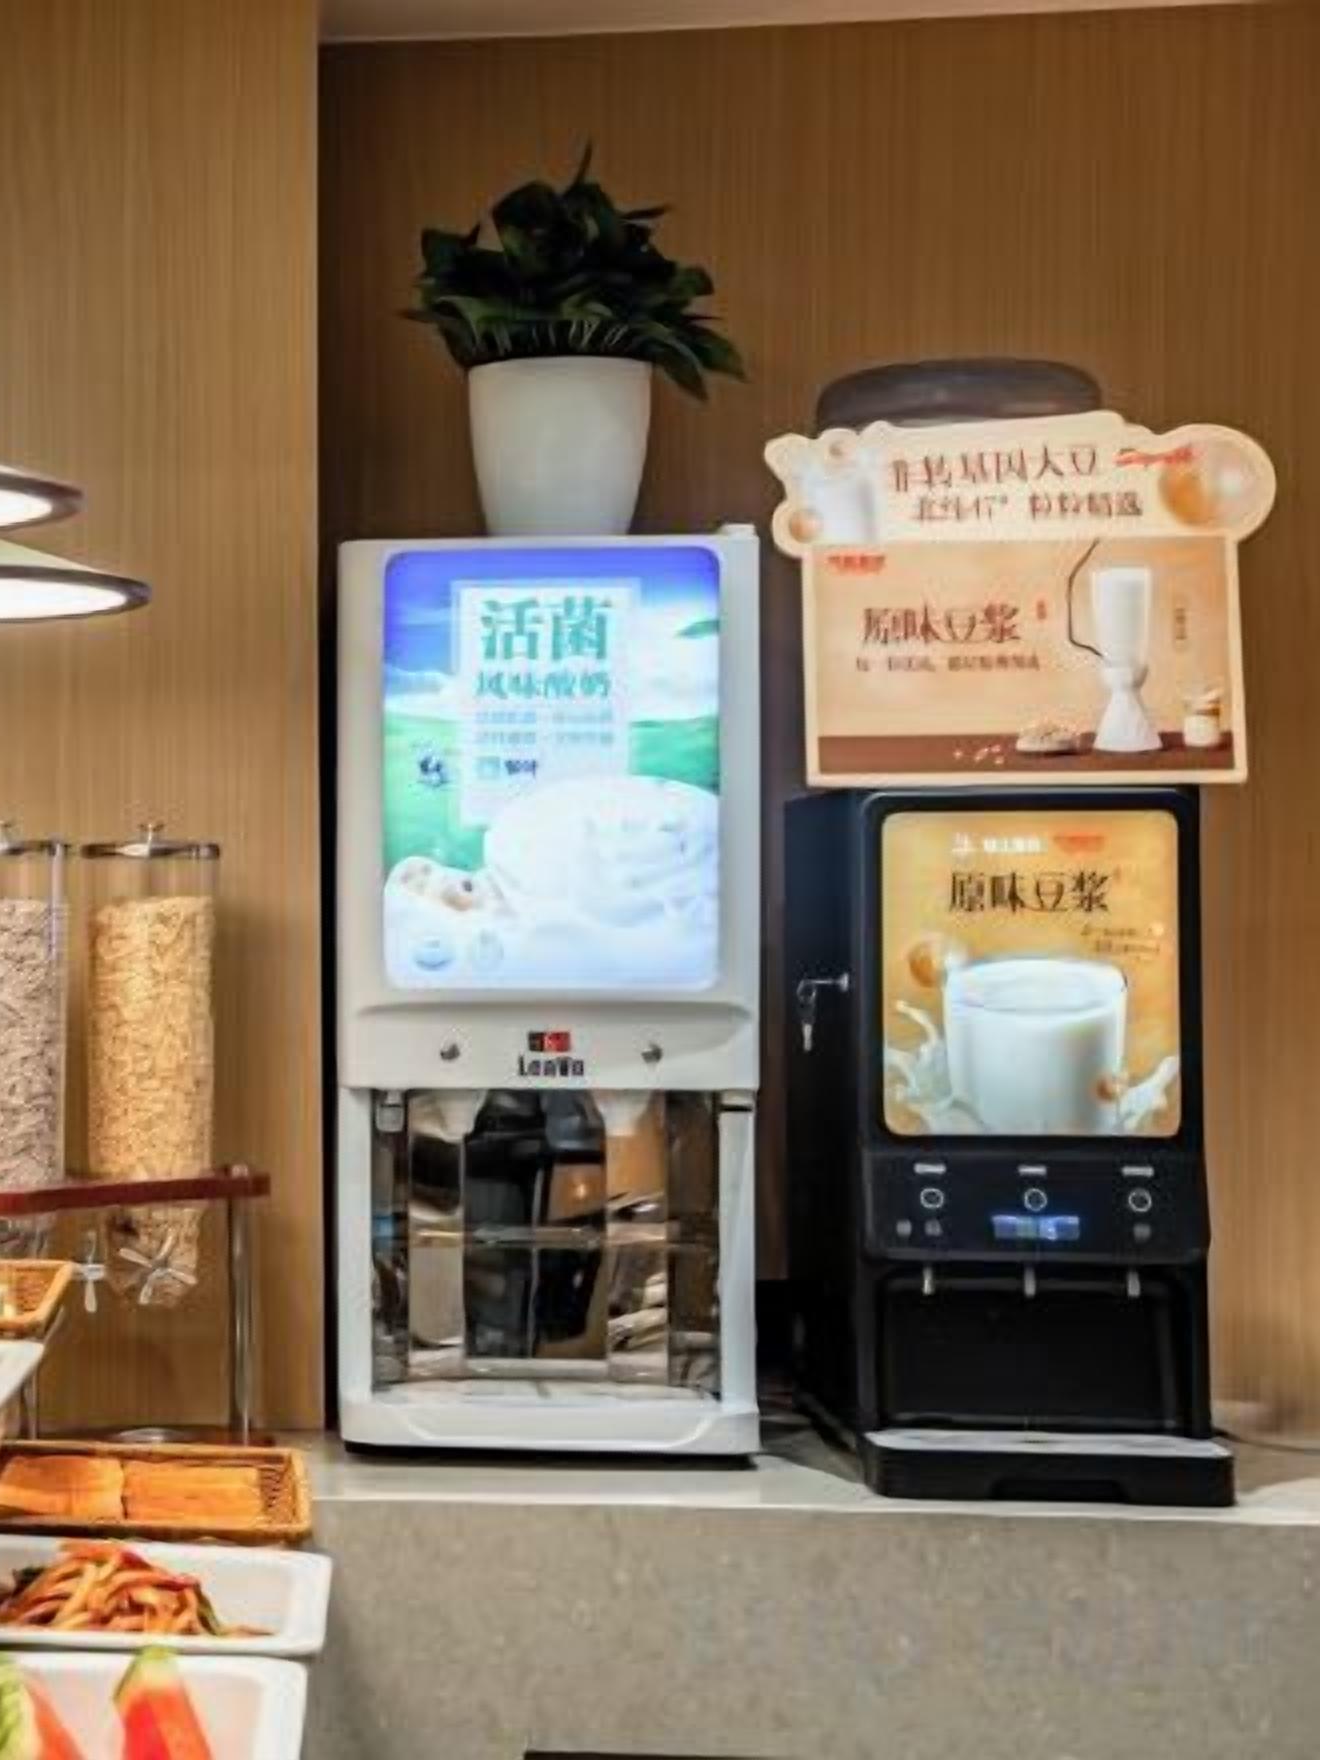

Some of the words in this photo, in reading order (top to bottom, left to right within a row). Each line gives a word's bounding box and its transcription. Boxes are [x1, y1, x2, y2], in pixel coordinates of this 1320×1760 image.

[479, 595, 612, 661] 活菌
[862, 601, 1022, 645] 原味豆浆
[949, 868, 1111, 915] 原味豆浆
